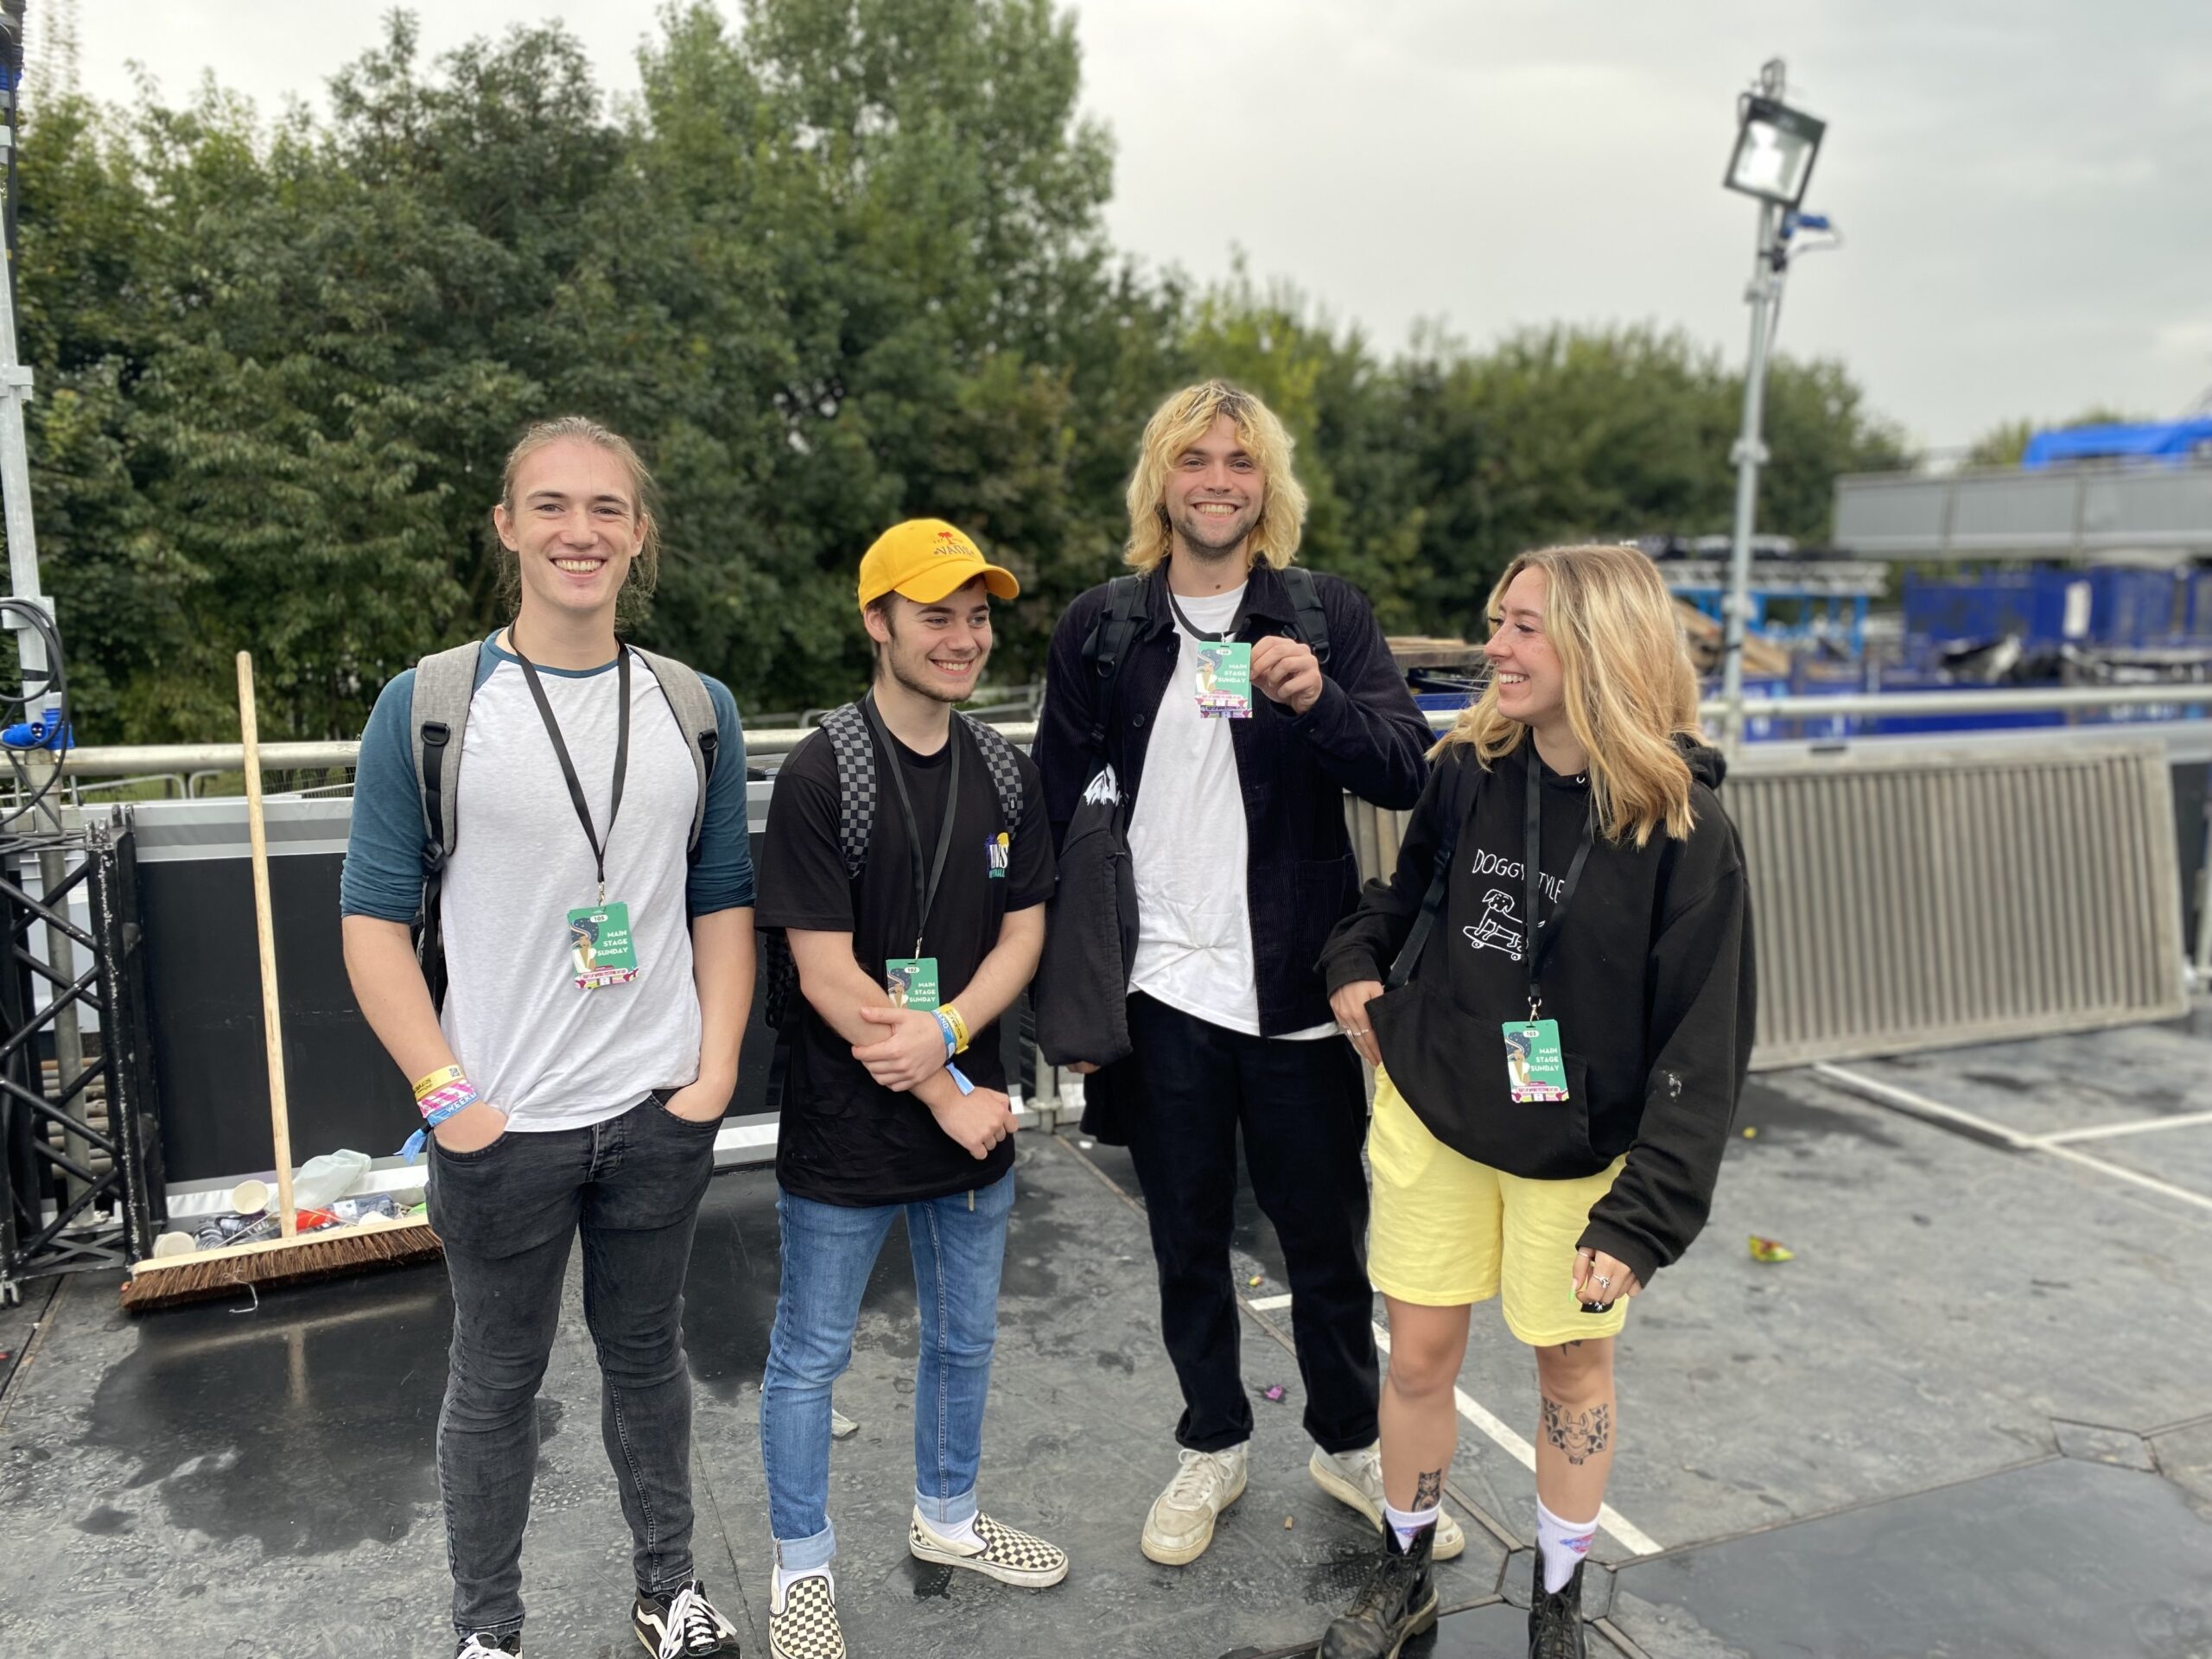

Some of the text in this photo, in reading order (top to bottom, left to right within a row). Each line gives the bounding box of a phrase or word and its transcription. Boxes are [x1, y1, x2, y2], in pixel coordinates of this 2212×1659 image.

[1536, 871, 1566, 904] TYLE
[603, 938, 628, 947] STAGE
[597, 947, 629, 957] SUNDAY
